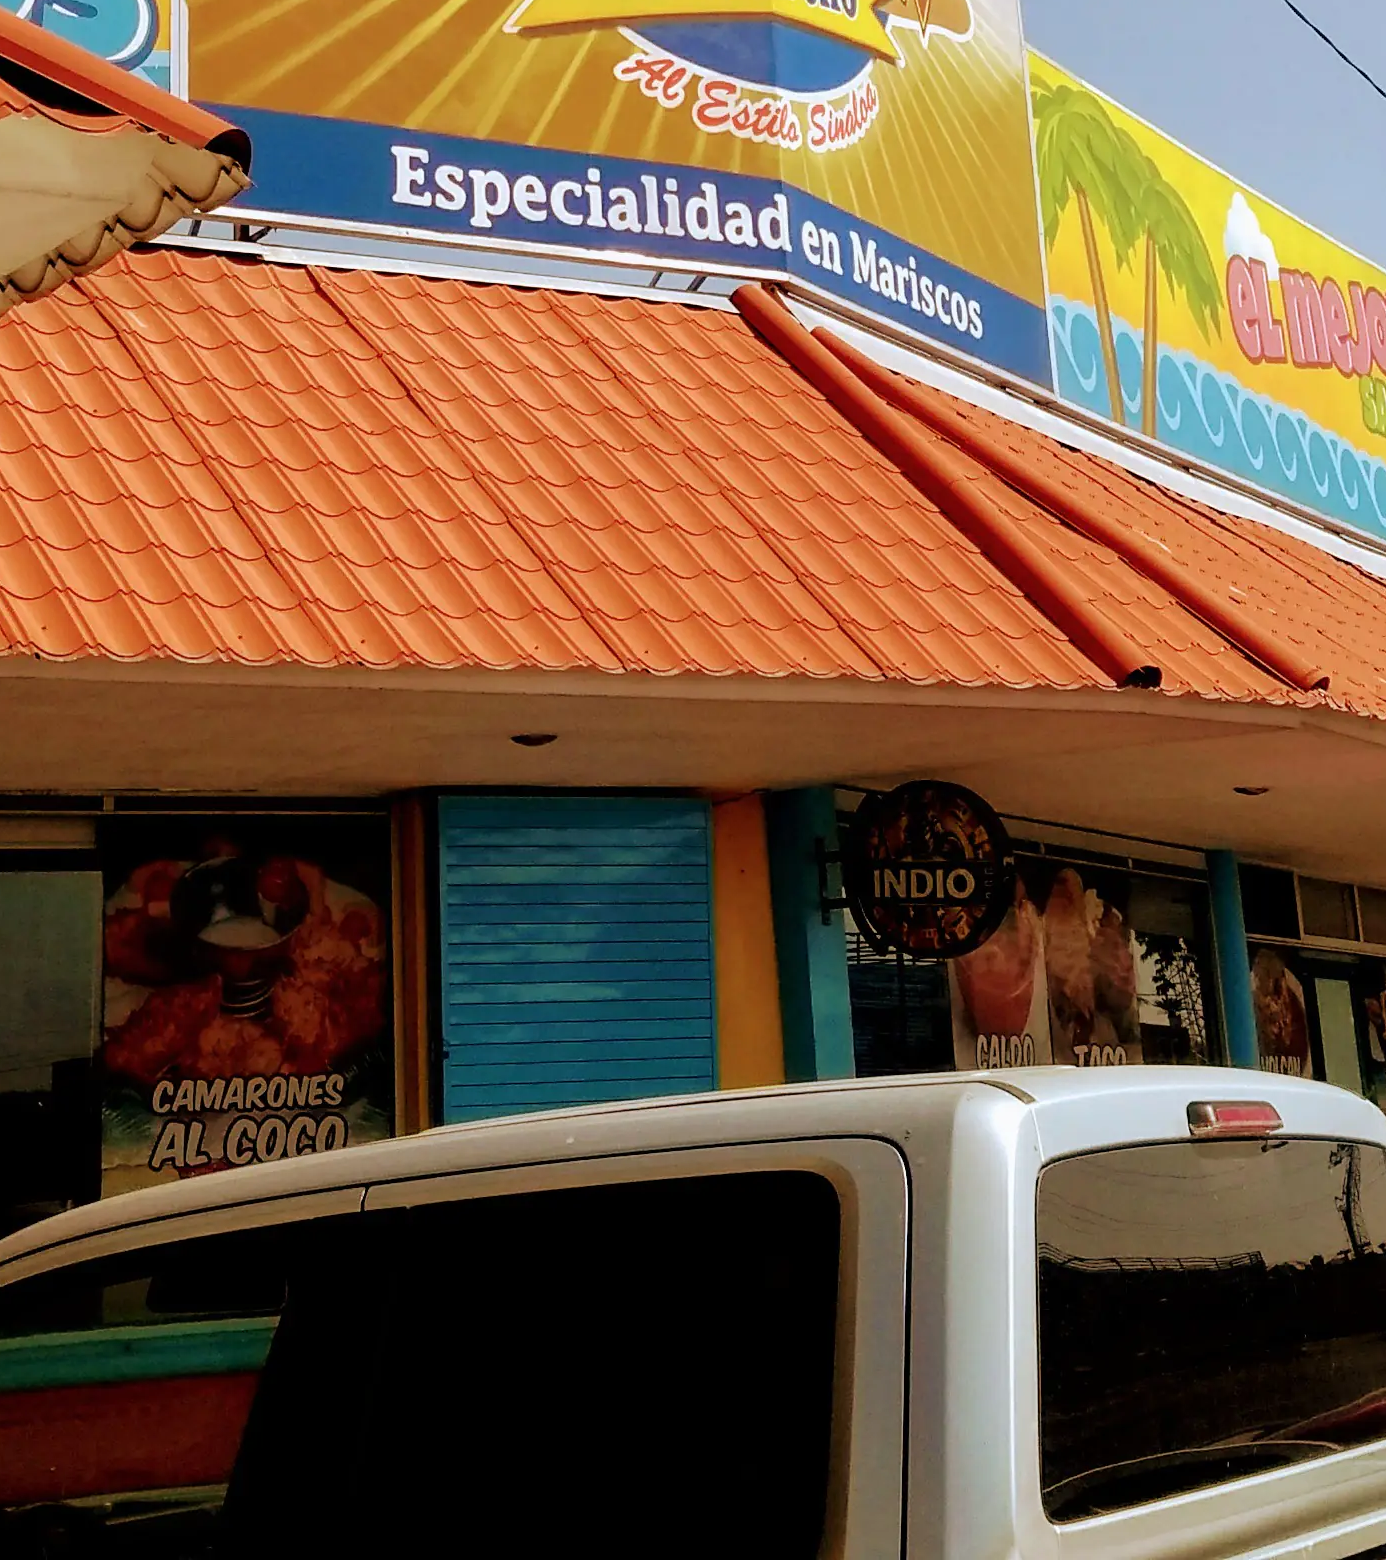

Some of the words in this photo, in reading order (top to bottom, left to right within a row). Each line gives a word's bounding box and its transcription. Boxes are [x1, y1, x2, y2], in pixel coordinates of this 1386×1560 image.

[621, 56, 684, 102] Al
[696, 80, 801, 143] Estilo
[809, 83, 878, 147] Sinaloa
[389, 144, 793, 254] Especialidad
[801, 219, 843, 269] en
[848, 235, 985, 341] Mariscos
[873, 866, 976, 900] INDIO
[976, 1033, 1036, 1070] CALDO
[152, 1073, 345, 1115] CAMARONES
[150, 1117, 212, 1172] AL
[224, 1114, 349, 1168] COCO
